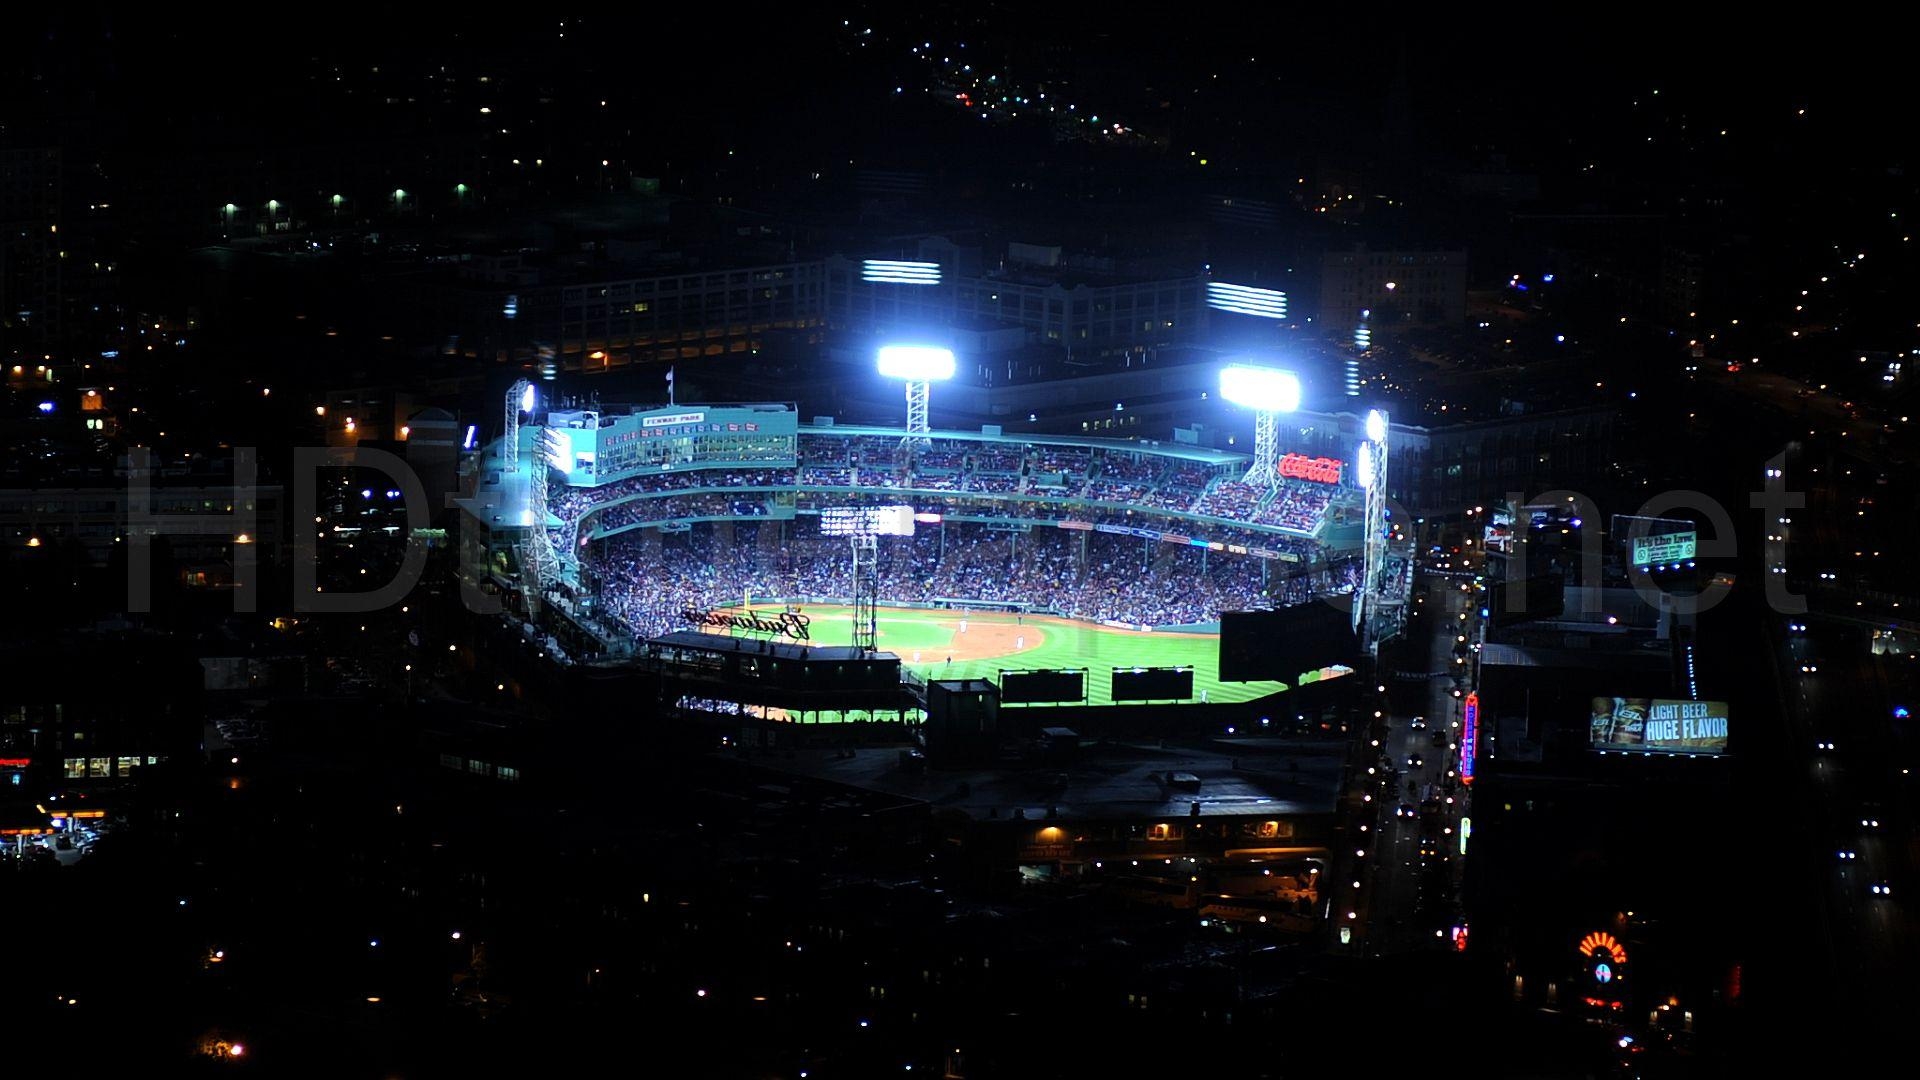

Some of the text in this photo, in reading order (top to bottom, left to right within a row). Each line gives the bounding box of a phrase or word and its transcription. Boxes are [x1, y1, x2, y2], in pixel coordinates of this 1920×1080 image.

[646, 417, 677, 425] FENWAY
[1651, 705, 1679, 720] LIGHT
[1683, 703, 1708, 718] BEER
[1646, 720, 1680, 740] HUGE
[1683, 718, 1728, 738] FLAVOR
